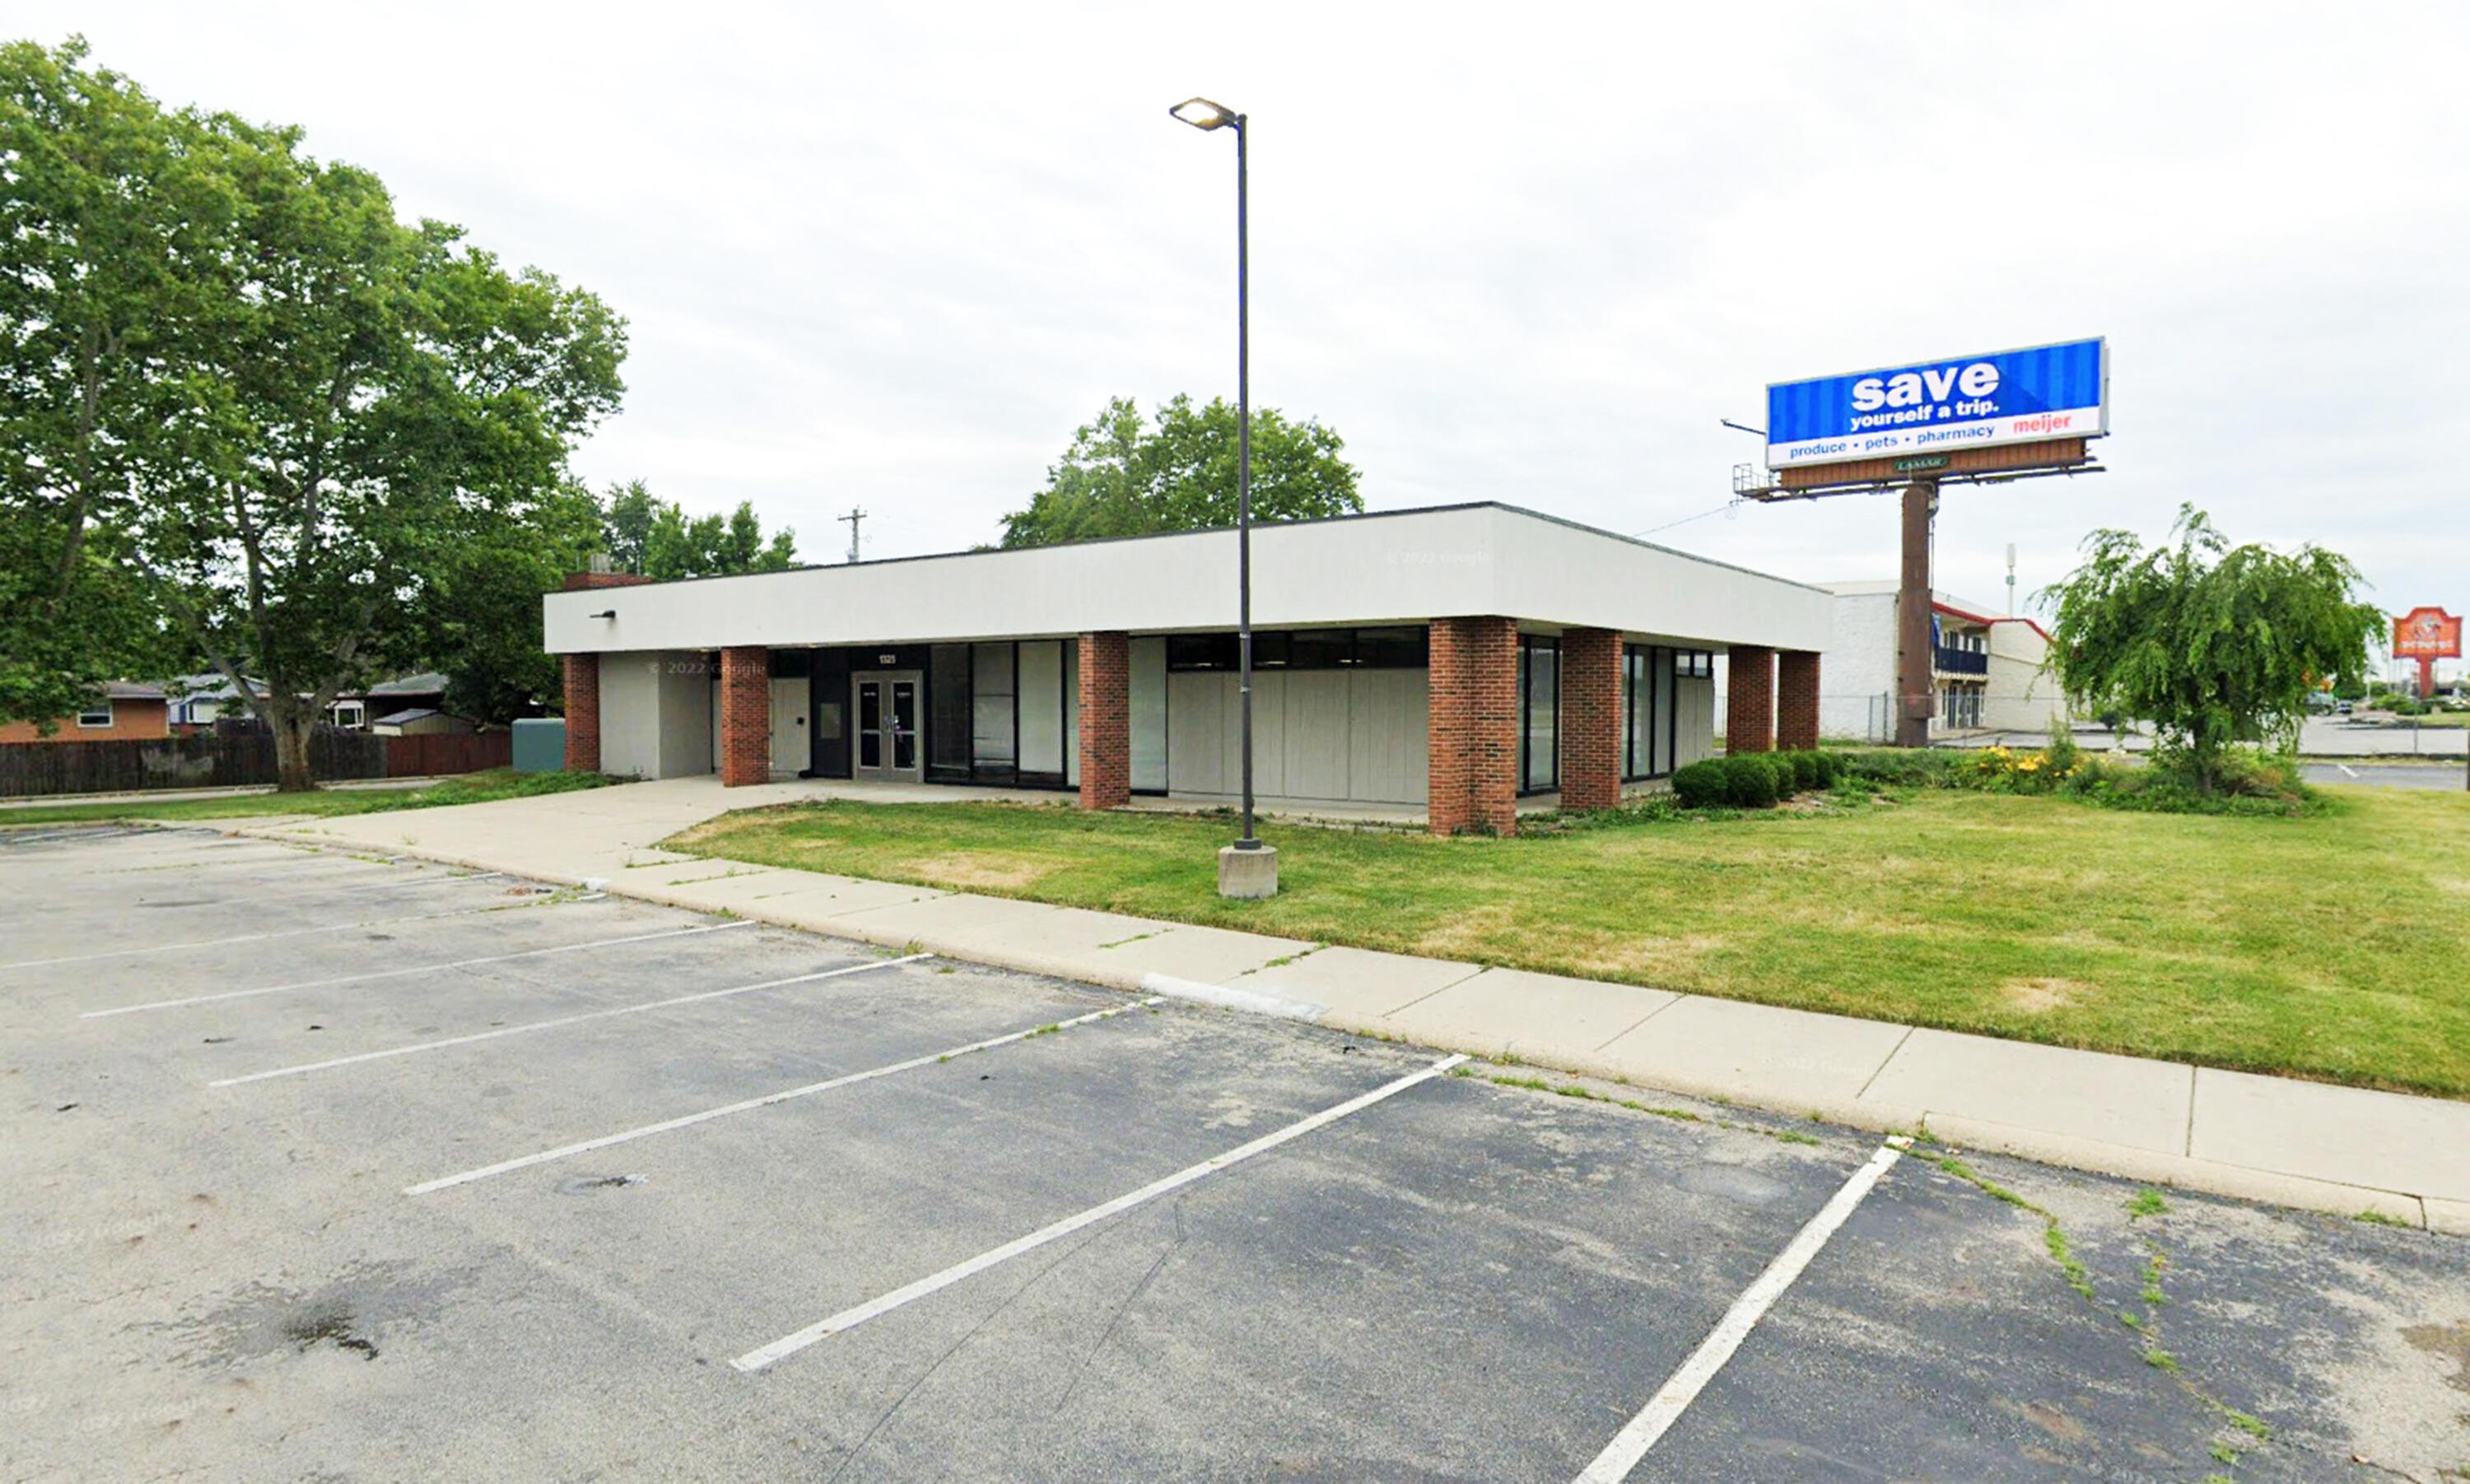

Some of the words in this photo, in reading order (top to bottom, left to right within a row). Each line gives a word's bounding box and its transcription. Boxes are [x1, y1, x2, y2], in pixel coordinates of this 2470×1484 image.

[1851, 362, 2000, 412] save
[1850, 404, 1934, 432] yourself
[1936, 405, 1951, 418] a
[1955, 398, 2000, 416] trip.
[2013, 414, 2072, 435] meijer
[1790, 443, 1847, 459] produce
[1865, 436, 1899, 450] pets
[1917, 425, 1995, 445] pharmacy
